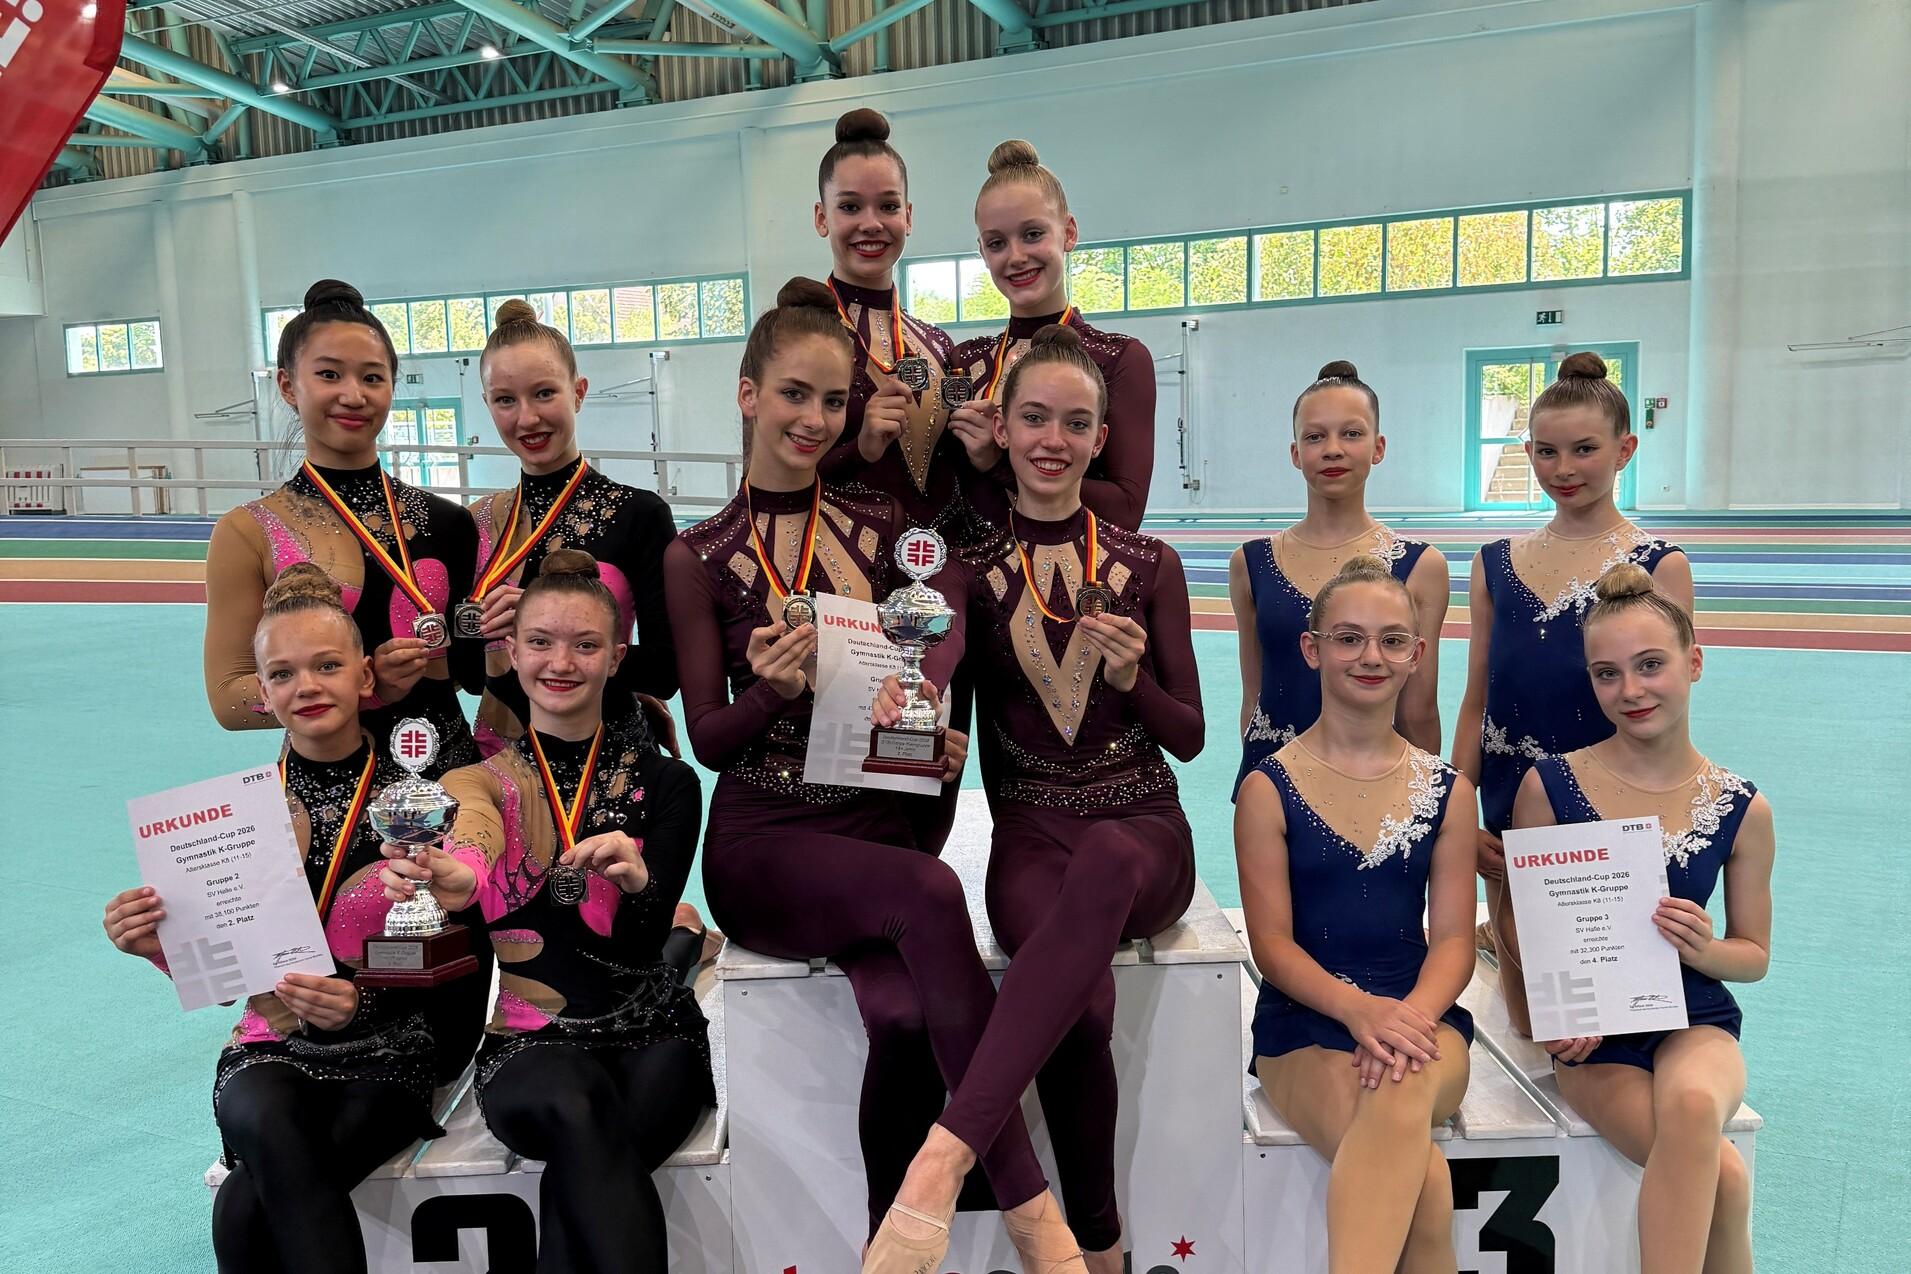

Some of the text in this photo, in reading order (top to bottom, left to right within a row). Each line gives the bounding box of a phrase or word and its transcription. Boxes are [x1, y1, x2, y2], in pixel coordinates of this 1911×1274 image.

[824, 614, 882, 634] URKUN
[850, 649, 886, 659] Gymnastik
[242, 773, 265, 784] DTB
[139, 804, 233, 838] URKUNDE
[1622, 823, 1644, 832] DTB
[170, 825, 256, 852] Deutschland-Cup 2026
[176, 840, 256, 865] Gymnastik K-Gruppe
[1513, 848, 1610, 869] URKUNDE
[206, 875, 233, 887] Gruppe
[1544, 871, 1630, 886] Deutschland-Cup 2026
[207, 890, 216, 898] SV
[1548, 885, 1629, 898] Gymnastik K-Gruppe
[236, 915, 255, 924] Platz
[1576, 915, 1603, 923] Gruppe
[1445, 1155, 1560, 1274] 3
